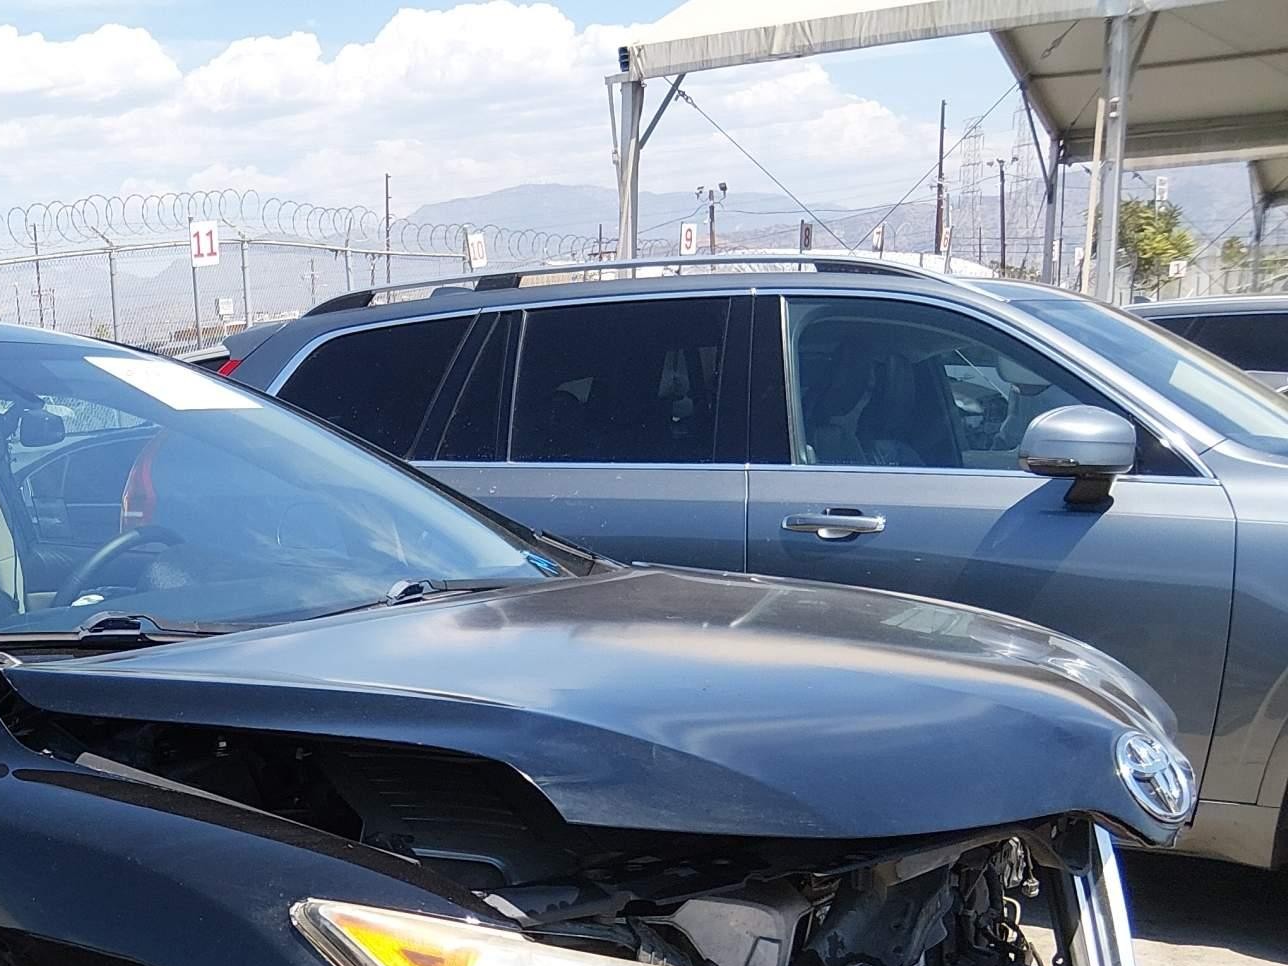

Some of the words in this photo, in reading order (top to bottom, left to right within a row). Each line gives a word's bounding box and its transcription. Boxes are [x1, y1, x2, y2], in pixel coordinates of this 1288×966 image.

[193, 230, 217, 258] 11
[685, 228, 692, 249] 9
[804, 227, 810, 248] 8
[471, 241, 484, 259] 10
